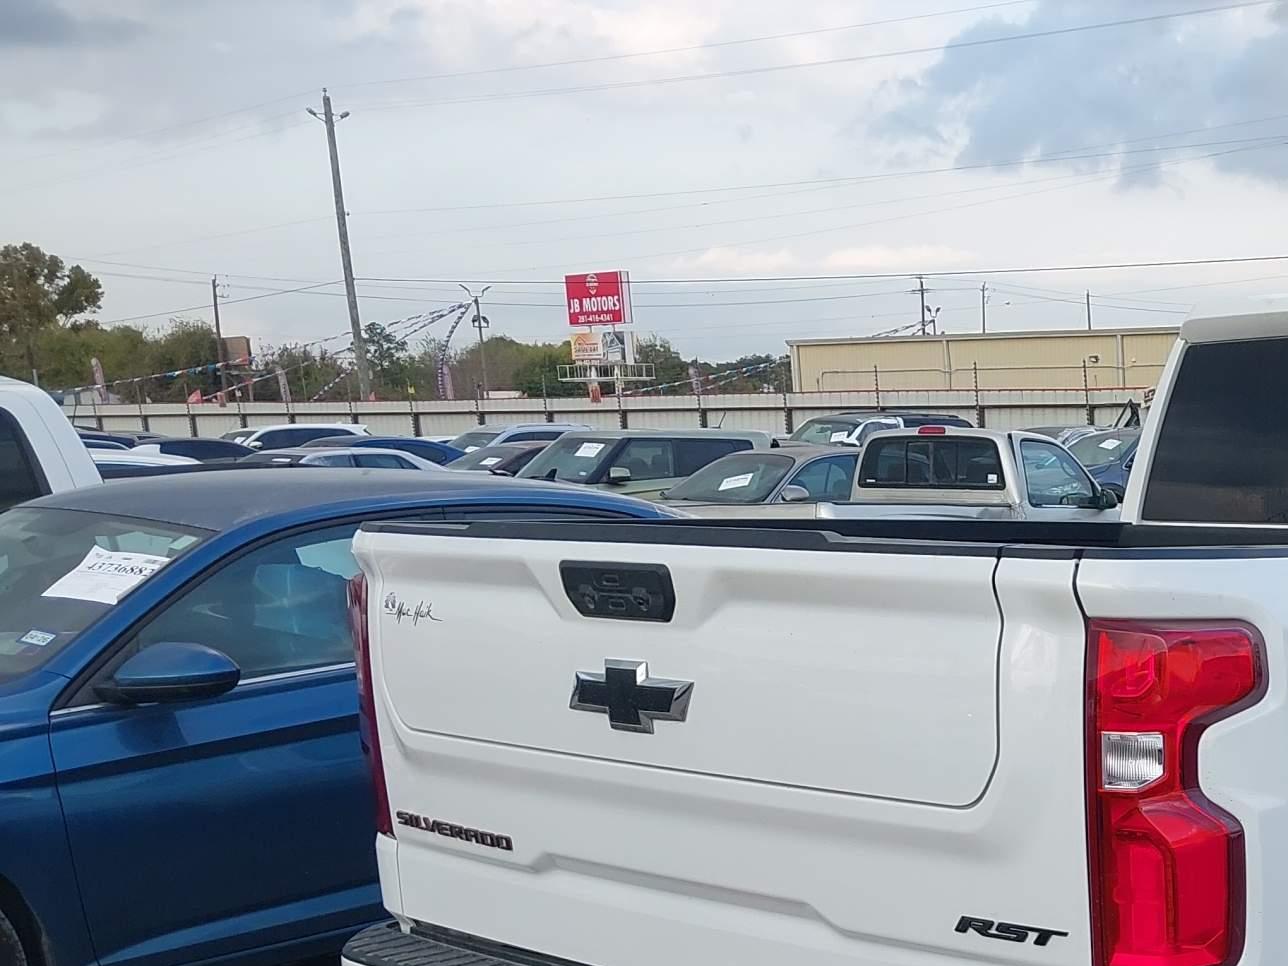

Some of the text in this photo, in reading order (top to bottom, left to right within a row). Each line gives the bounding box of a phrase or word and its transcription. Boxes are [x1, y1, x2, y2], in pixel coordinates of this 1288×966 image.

[569, 295, 620, 314] JB MOTORS
[395, 809, 514, 852] SILVERADO
[954, 915, 1069, 946] RST
